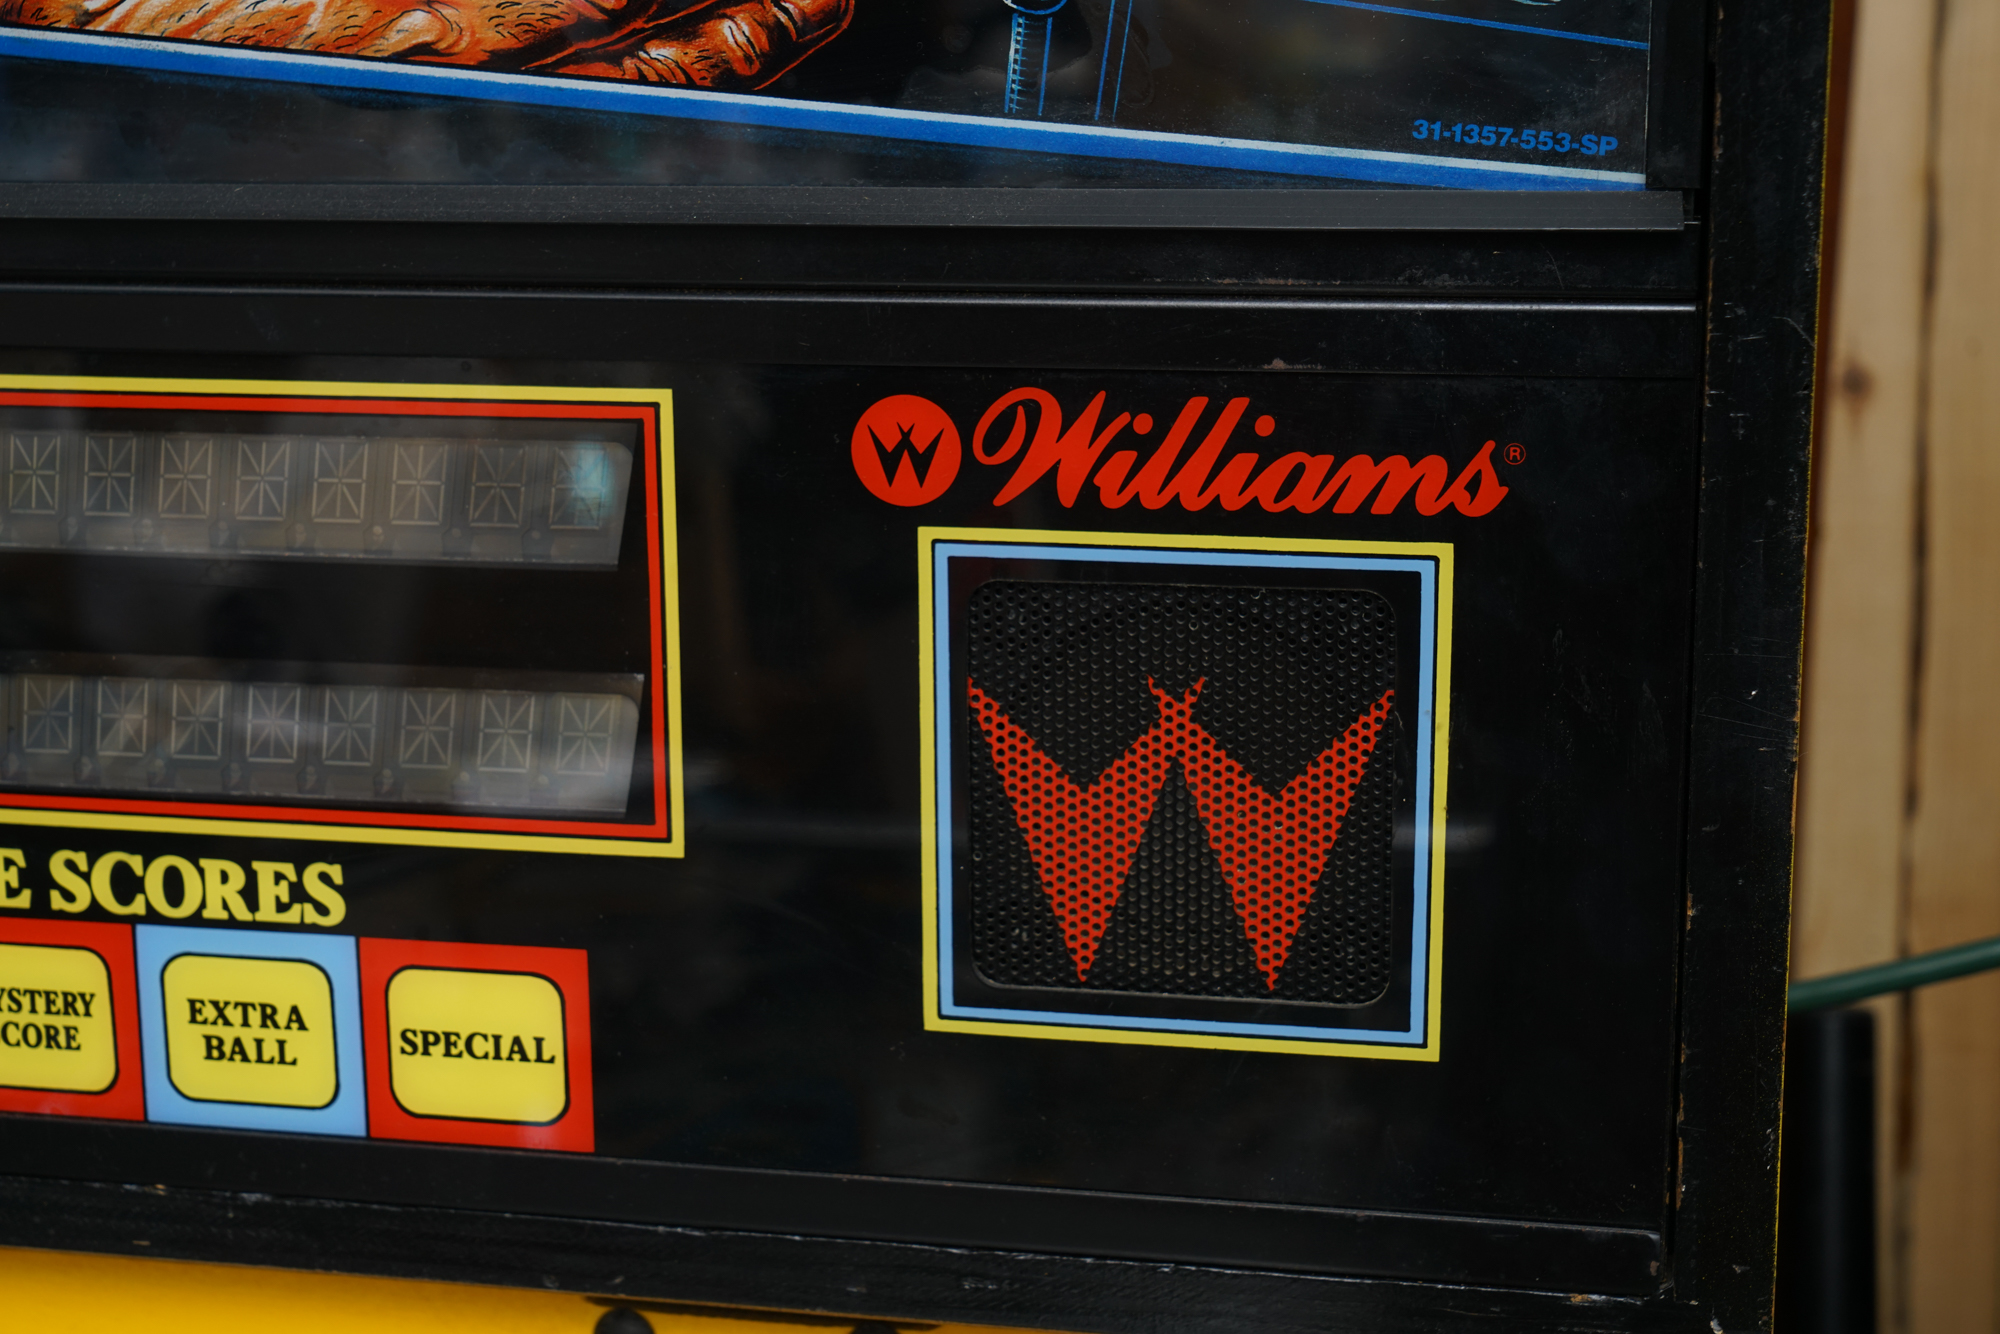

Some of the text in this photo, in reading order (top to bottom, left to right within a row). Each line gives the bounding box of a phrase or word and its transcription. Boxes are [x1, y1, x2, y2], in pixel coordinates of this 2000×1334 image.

[1412, 119, 1618, 156] 31-1357-553-SP
[973, 386, 1510, 517] Williams
[49, 849, 347, 927] SCORES
[187, 998, 309, 1032] EXTRA
[203, 1035, 298, 1066] BALL
[399, 1028, 556, 1064] SPECIAL
